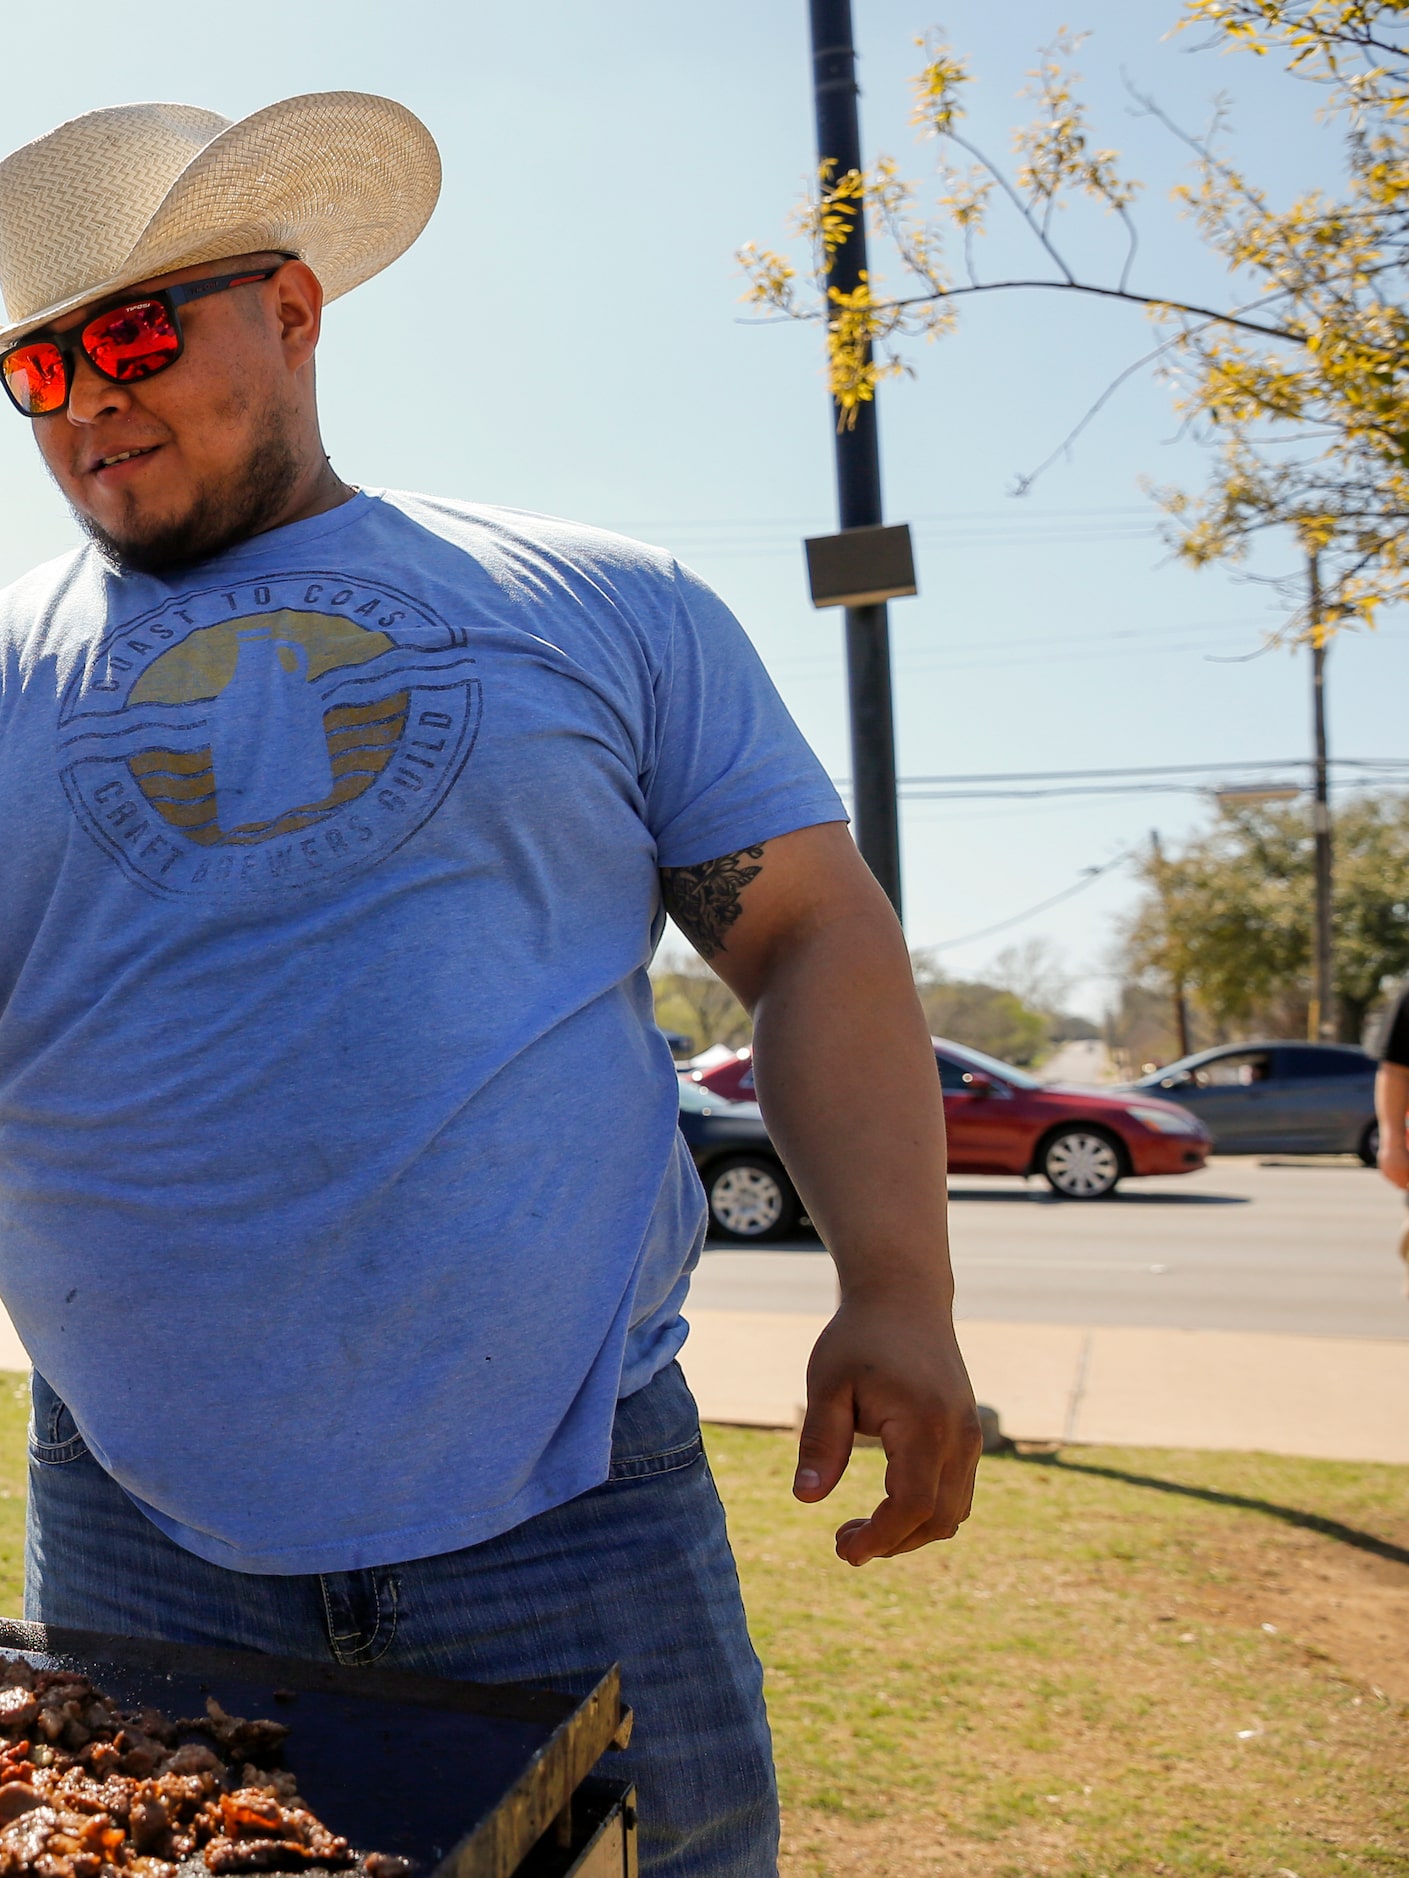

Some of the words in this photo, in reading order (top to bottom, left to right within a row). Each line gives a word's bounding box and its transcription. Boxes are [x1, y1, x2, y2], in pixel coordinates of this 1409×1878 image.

[92, 609, 194, 692] COAST
[221, 586, 271, 611] TO
[304, 584, 412, 628] COAS
[94, 781, 184, 874] CRAFT
[377, 711, 453, 813] GUILD
